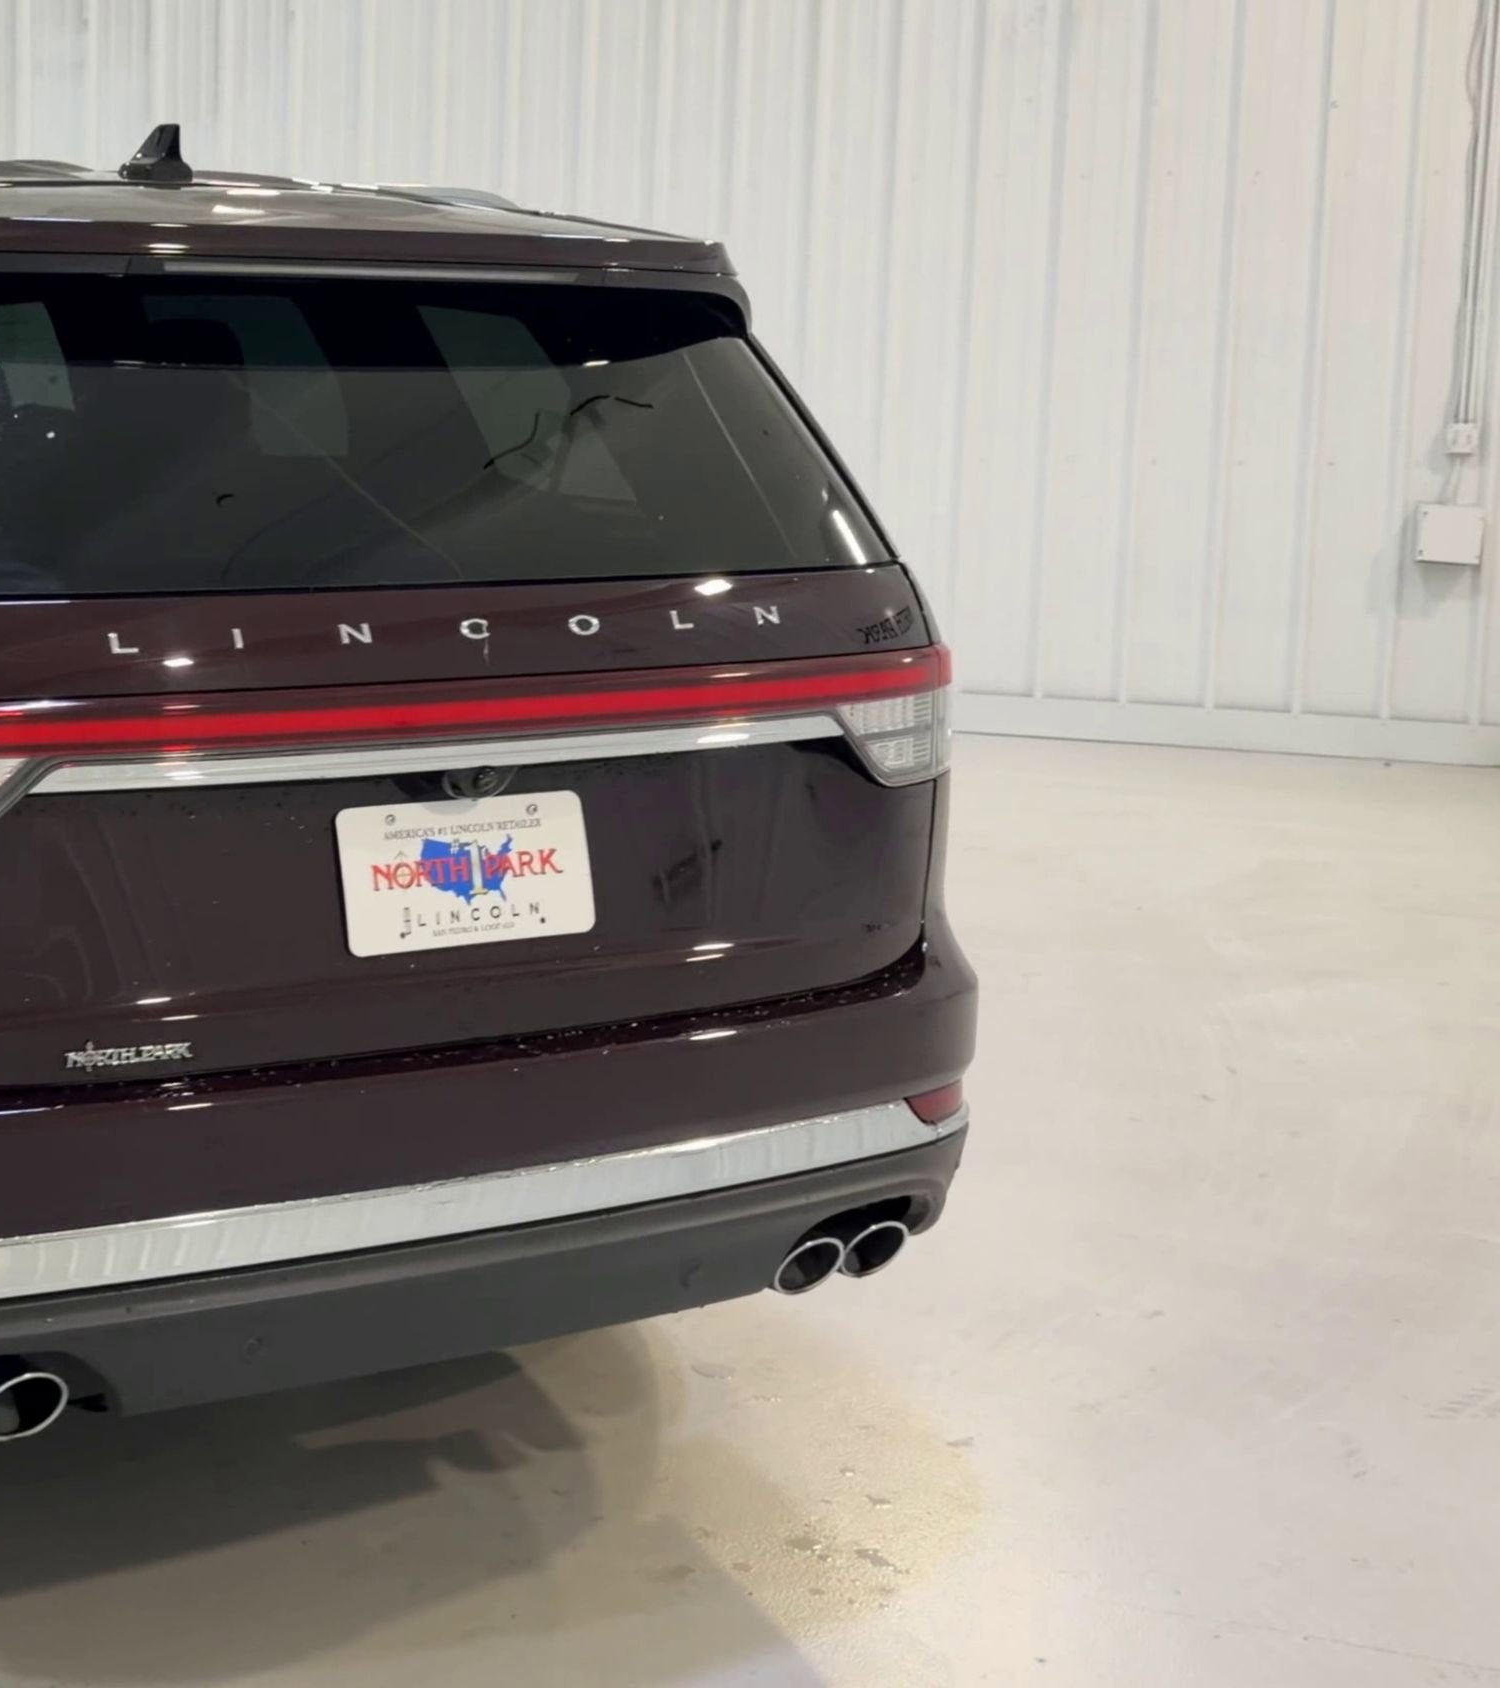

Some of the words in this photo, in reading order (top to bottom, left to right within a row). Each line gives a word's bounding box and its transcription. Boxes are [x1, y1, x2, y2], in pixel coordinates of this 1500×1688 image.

[107, 605, 781, 655] LINCOLN
[450, 822, 495, 836] LINCOLN
[497, 817, 542, 831] RETAILER
[371, 853, 471, 892] NORTH
[483, 848, 564, 881] PARK
[417, 901, 540, 928] LINCOLN
